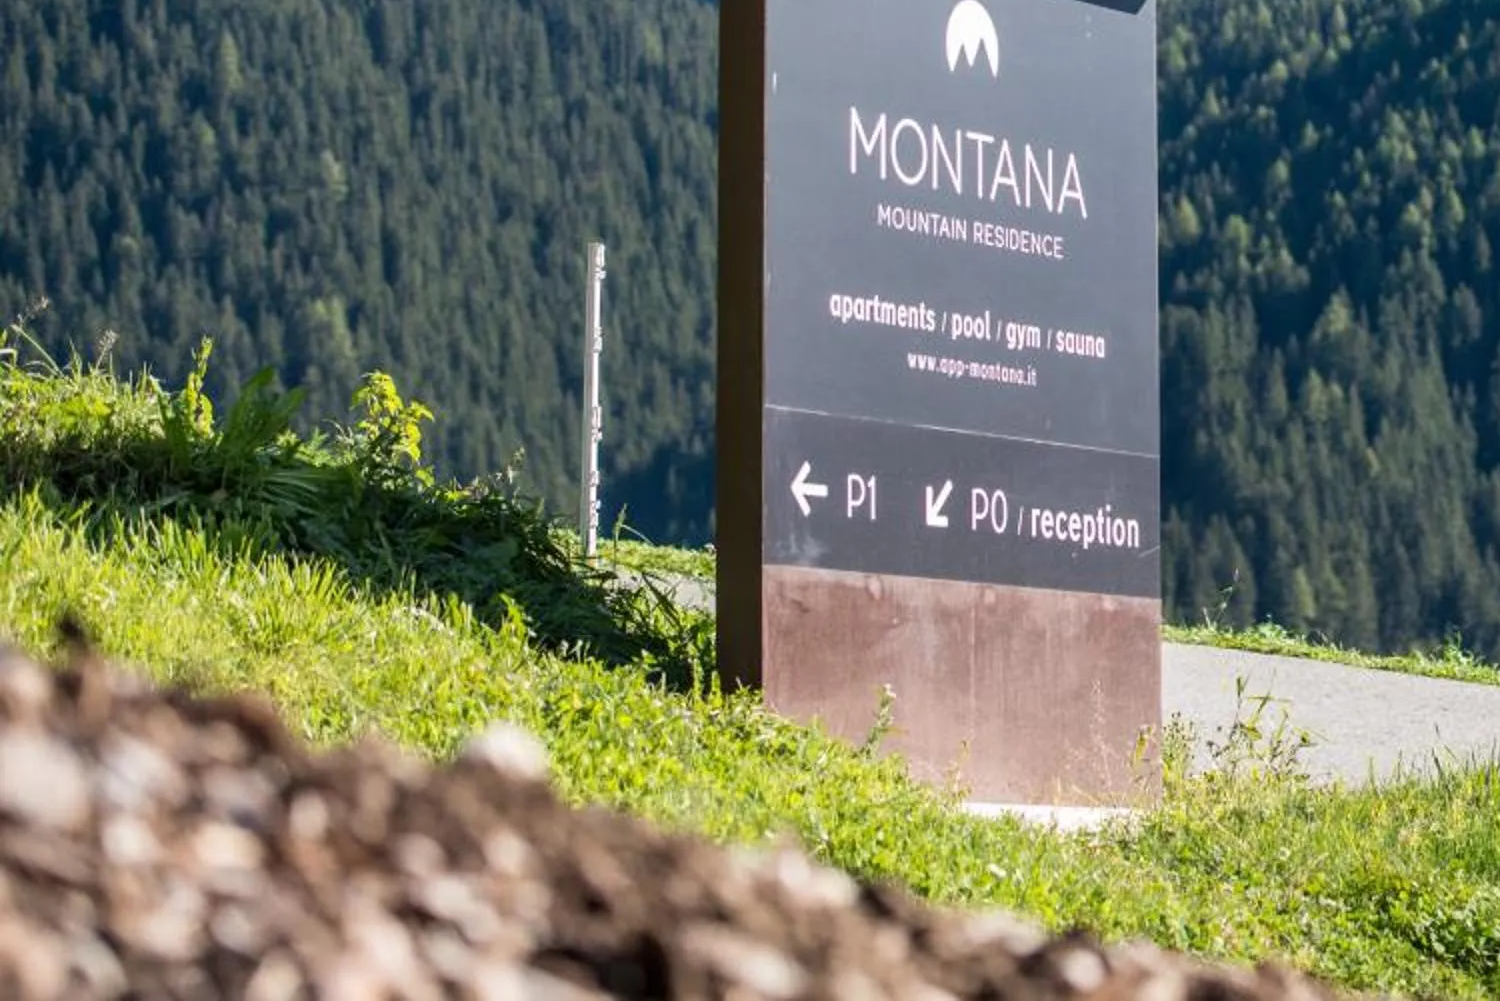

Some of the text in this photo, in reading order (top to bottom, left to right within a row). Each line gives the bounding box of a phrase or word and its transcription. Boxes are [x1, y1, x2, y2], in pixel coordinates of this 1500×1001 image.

[849, 106, 1088, 220] MONTANA
[877, 203, 1064, 260] MOUNTAIN RESIDENCE
[829, 293, 936, 332] apartments
[950, 310, 992, 341] pool
[1005, 321, 1042, 351] gym
[1055, 329, 1106, 359] sauna
[846, 472, 877, 521] P1
[1030, 503, 1140, 550] reception
